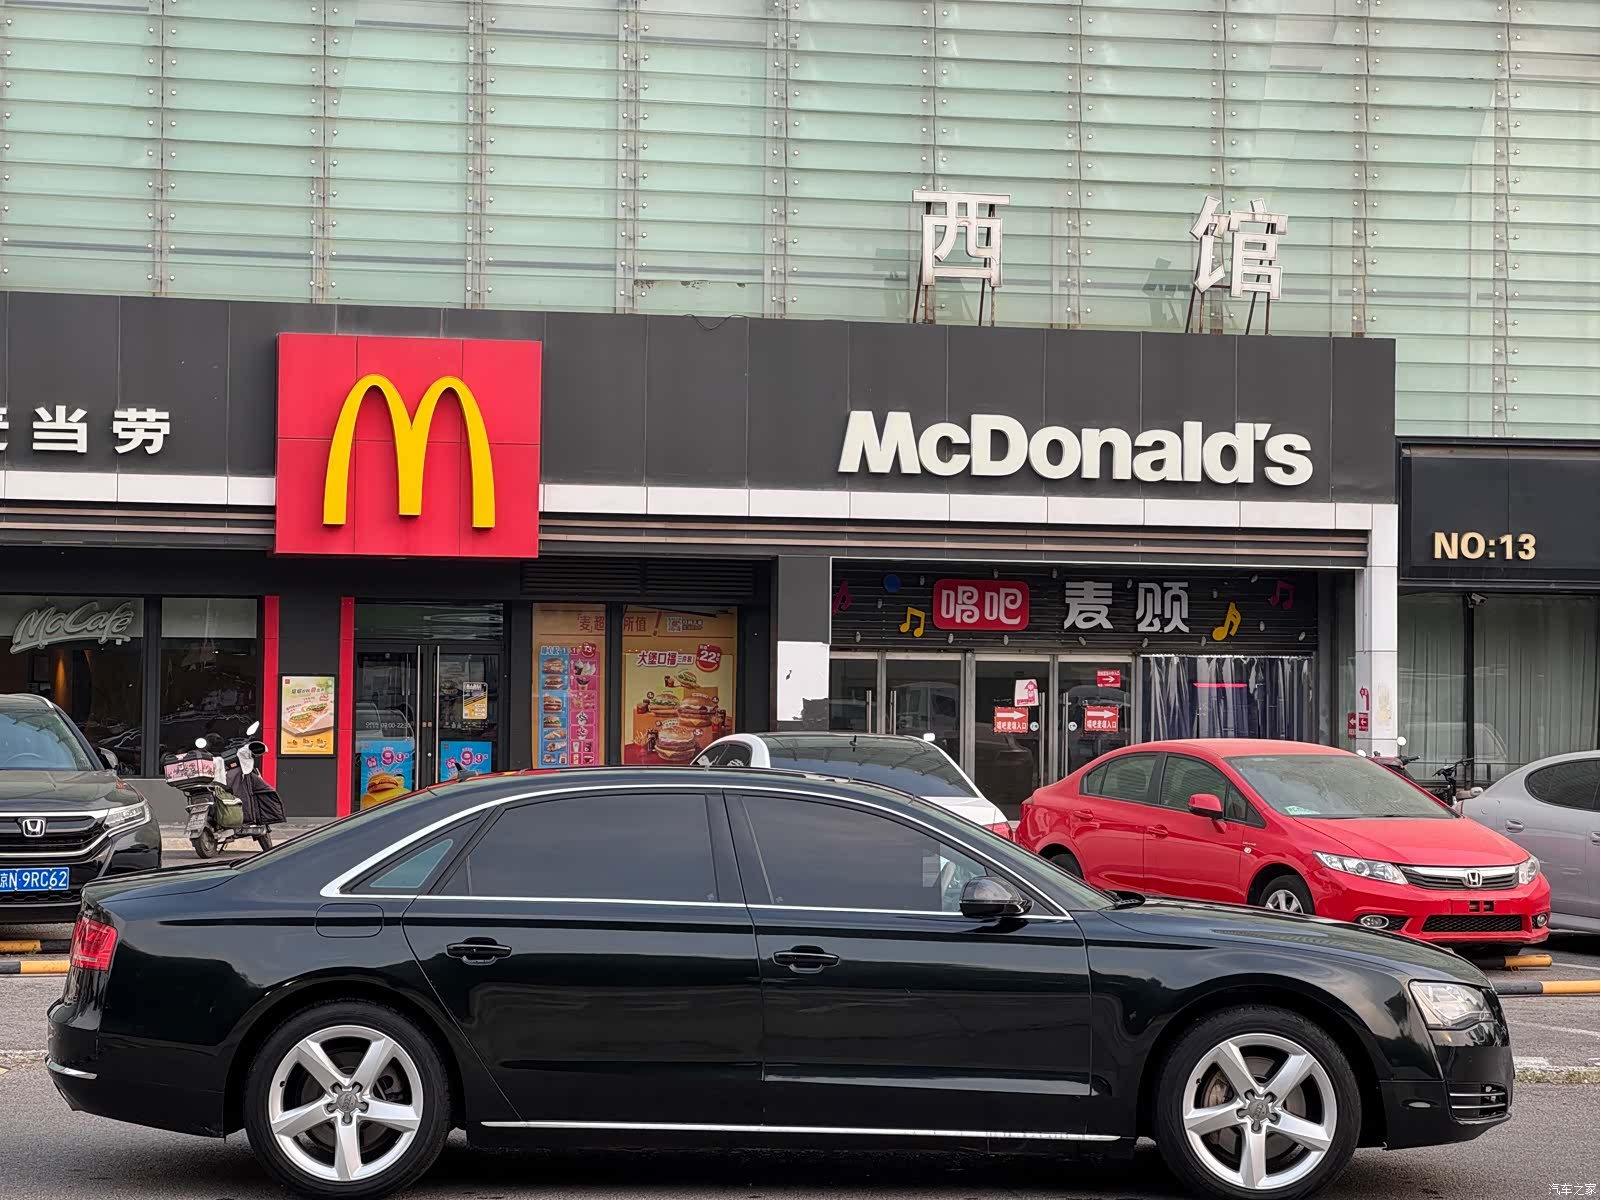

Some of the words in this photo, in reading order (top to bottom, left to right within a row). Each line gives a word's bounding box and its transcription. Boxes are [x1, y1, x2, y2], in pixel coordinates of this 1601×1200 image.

[0, 405, 170, 455] 当劳
[838, 410, 1313, 486] McDonald's
[1434, 531, 1537, 560] NO:13
[940, 585, 1023, 625] 唱吧
[1063, 581, 1190, 634] 麦颂
